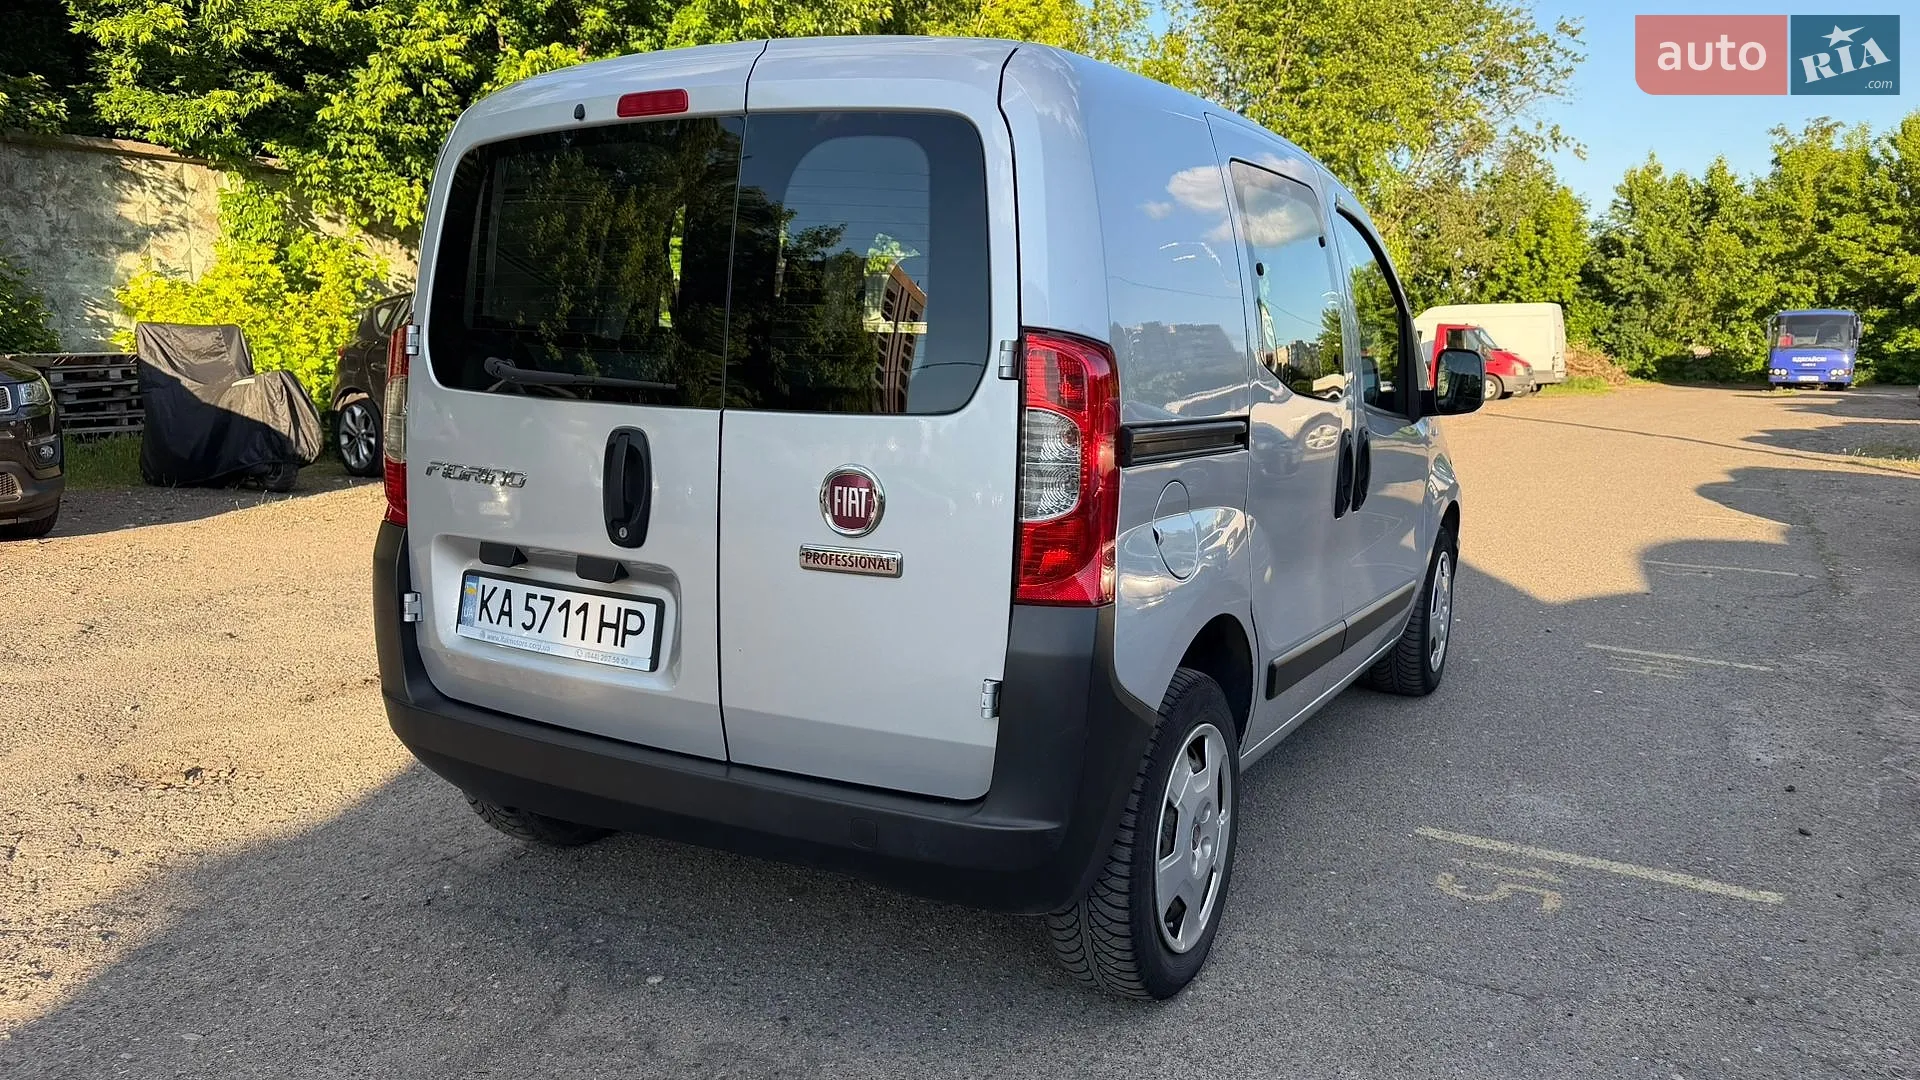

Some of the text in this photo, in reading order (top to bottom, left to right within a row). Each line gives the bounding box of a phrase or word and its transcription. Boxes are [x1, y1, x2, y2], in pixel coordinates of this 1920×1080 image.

[425, 461, 528, 488] FIORINO
[834, 486, 869, 518] FIAT
[805, 551, 893, 571] PROFESSIONAL
[478, 584, 646, 648] KA 5711 HP
